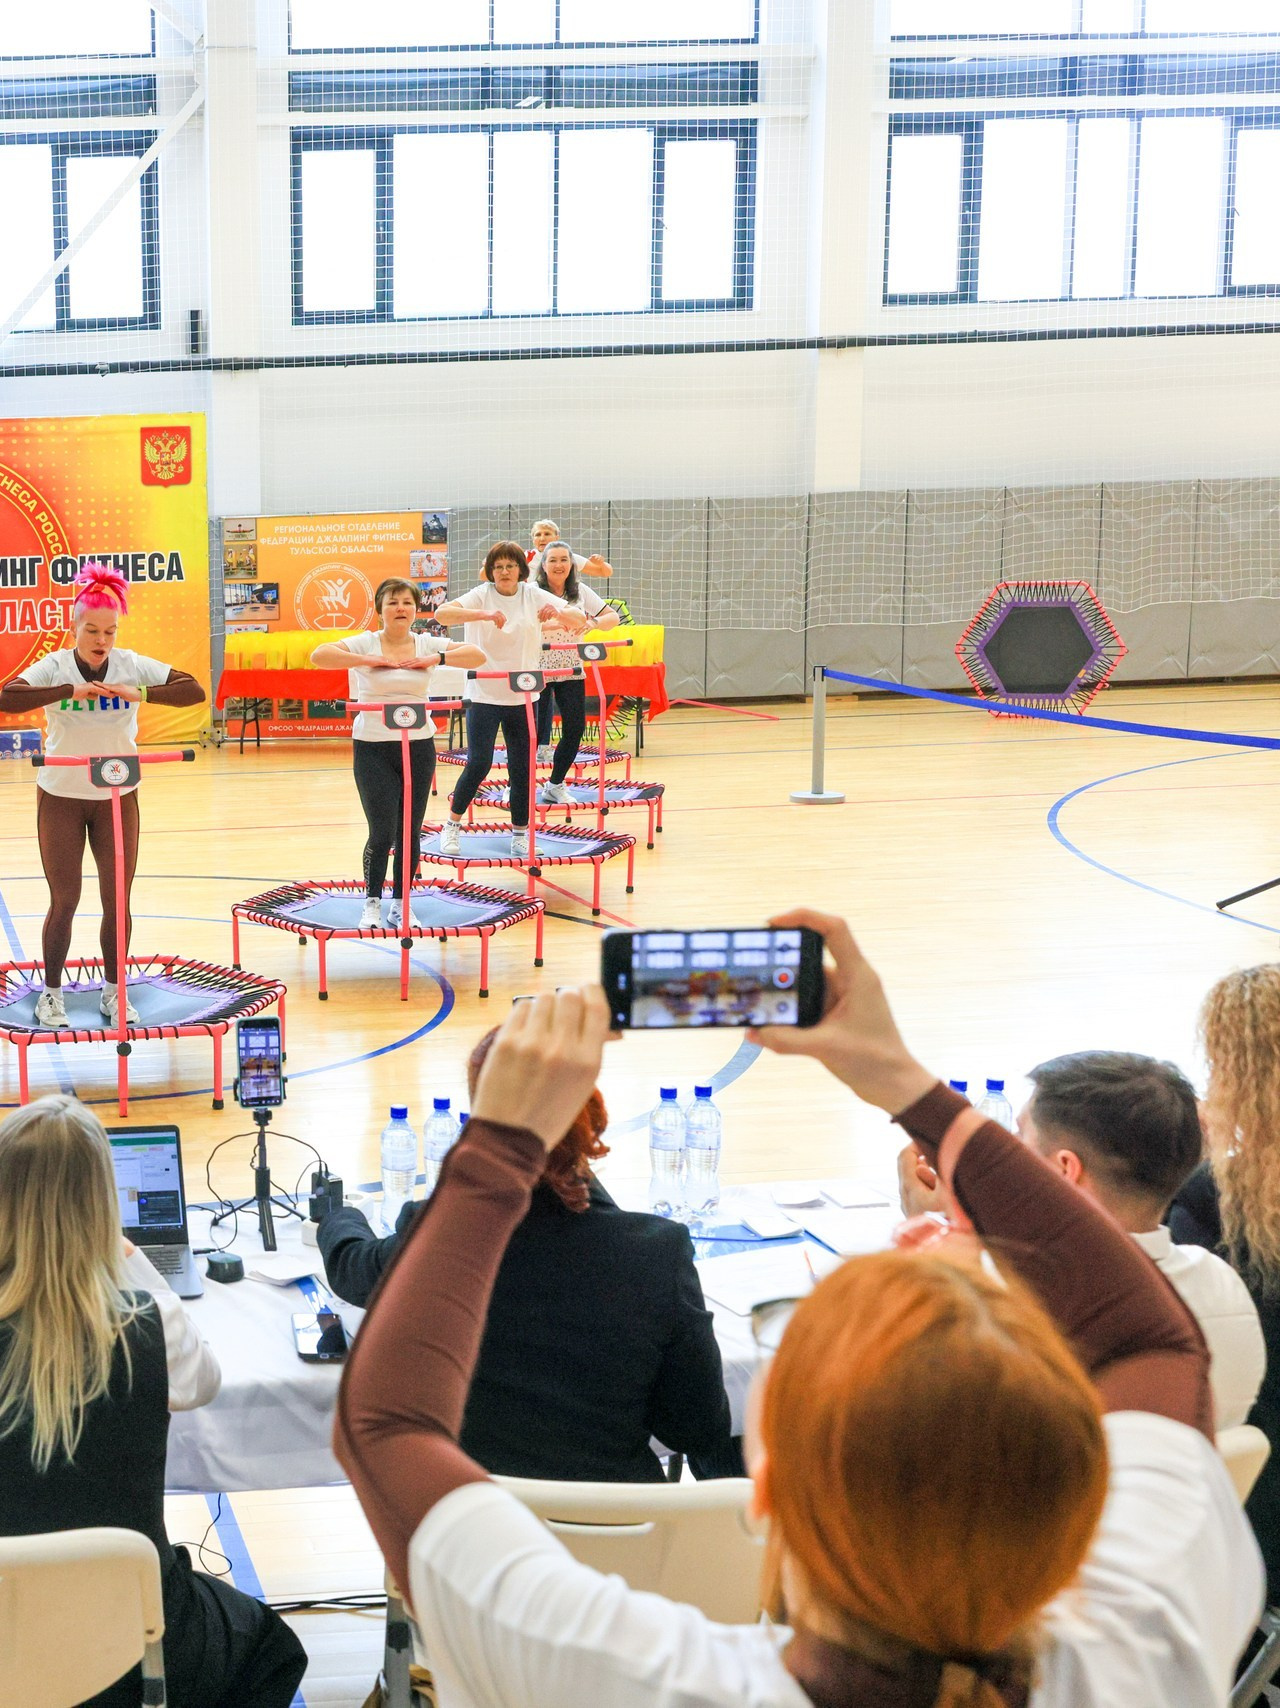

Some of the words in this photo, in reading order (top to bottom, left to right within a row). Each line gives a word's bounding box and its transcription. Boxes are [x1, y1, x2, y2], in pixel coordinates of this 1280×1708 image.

[35, 511, 63, 555] РОСС
[274, 523, 346, 534] РЕГИОНАЛЬНОЕ
[347, 522, 400, 532] ОТДЕЛЕНИЕ
[260, 536, 314, 545] ФЕДЕРАЦИИ
[317, 534, 370, 544] ДЖАМПИНГ
[372, 532, 415, 542] ФИТНЕСА
[290, 545, 338, 555] ТУЛЬСКОЙ
[340, 545, 384, 554] ОБЛАСТИ
[12, 733, 22, 750] 3
